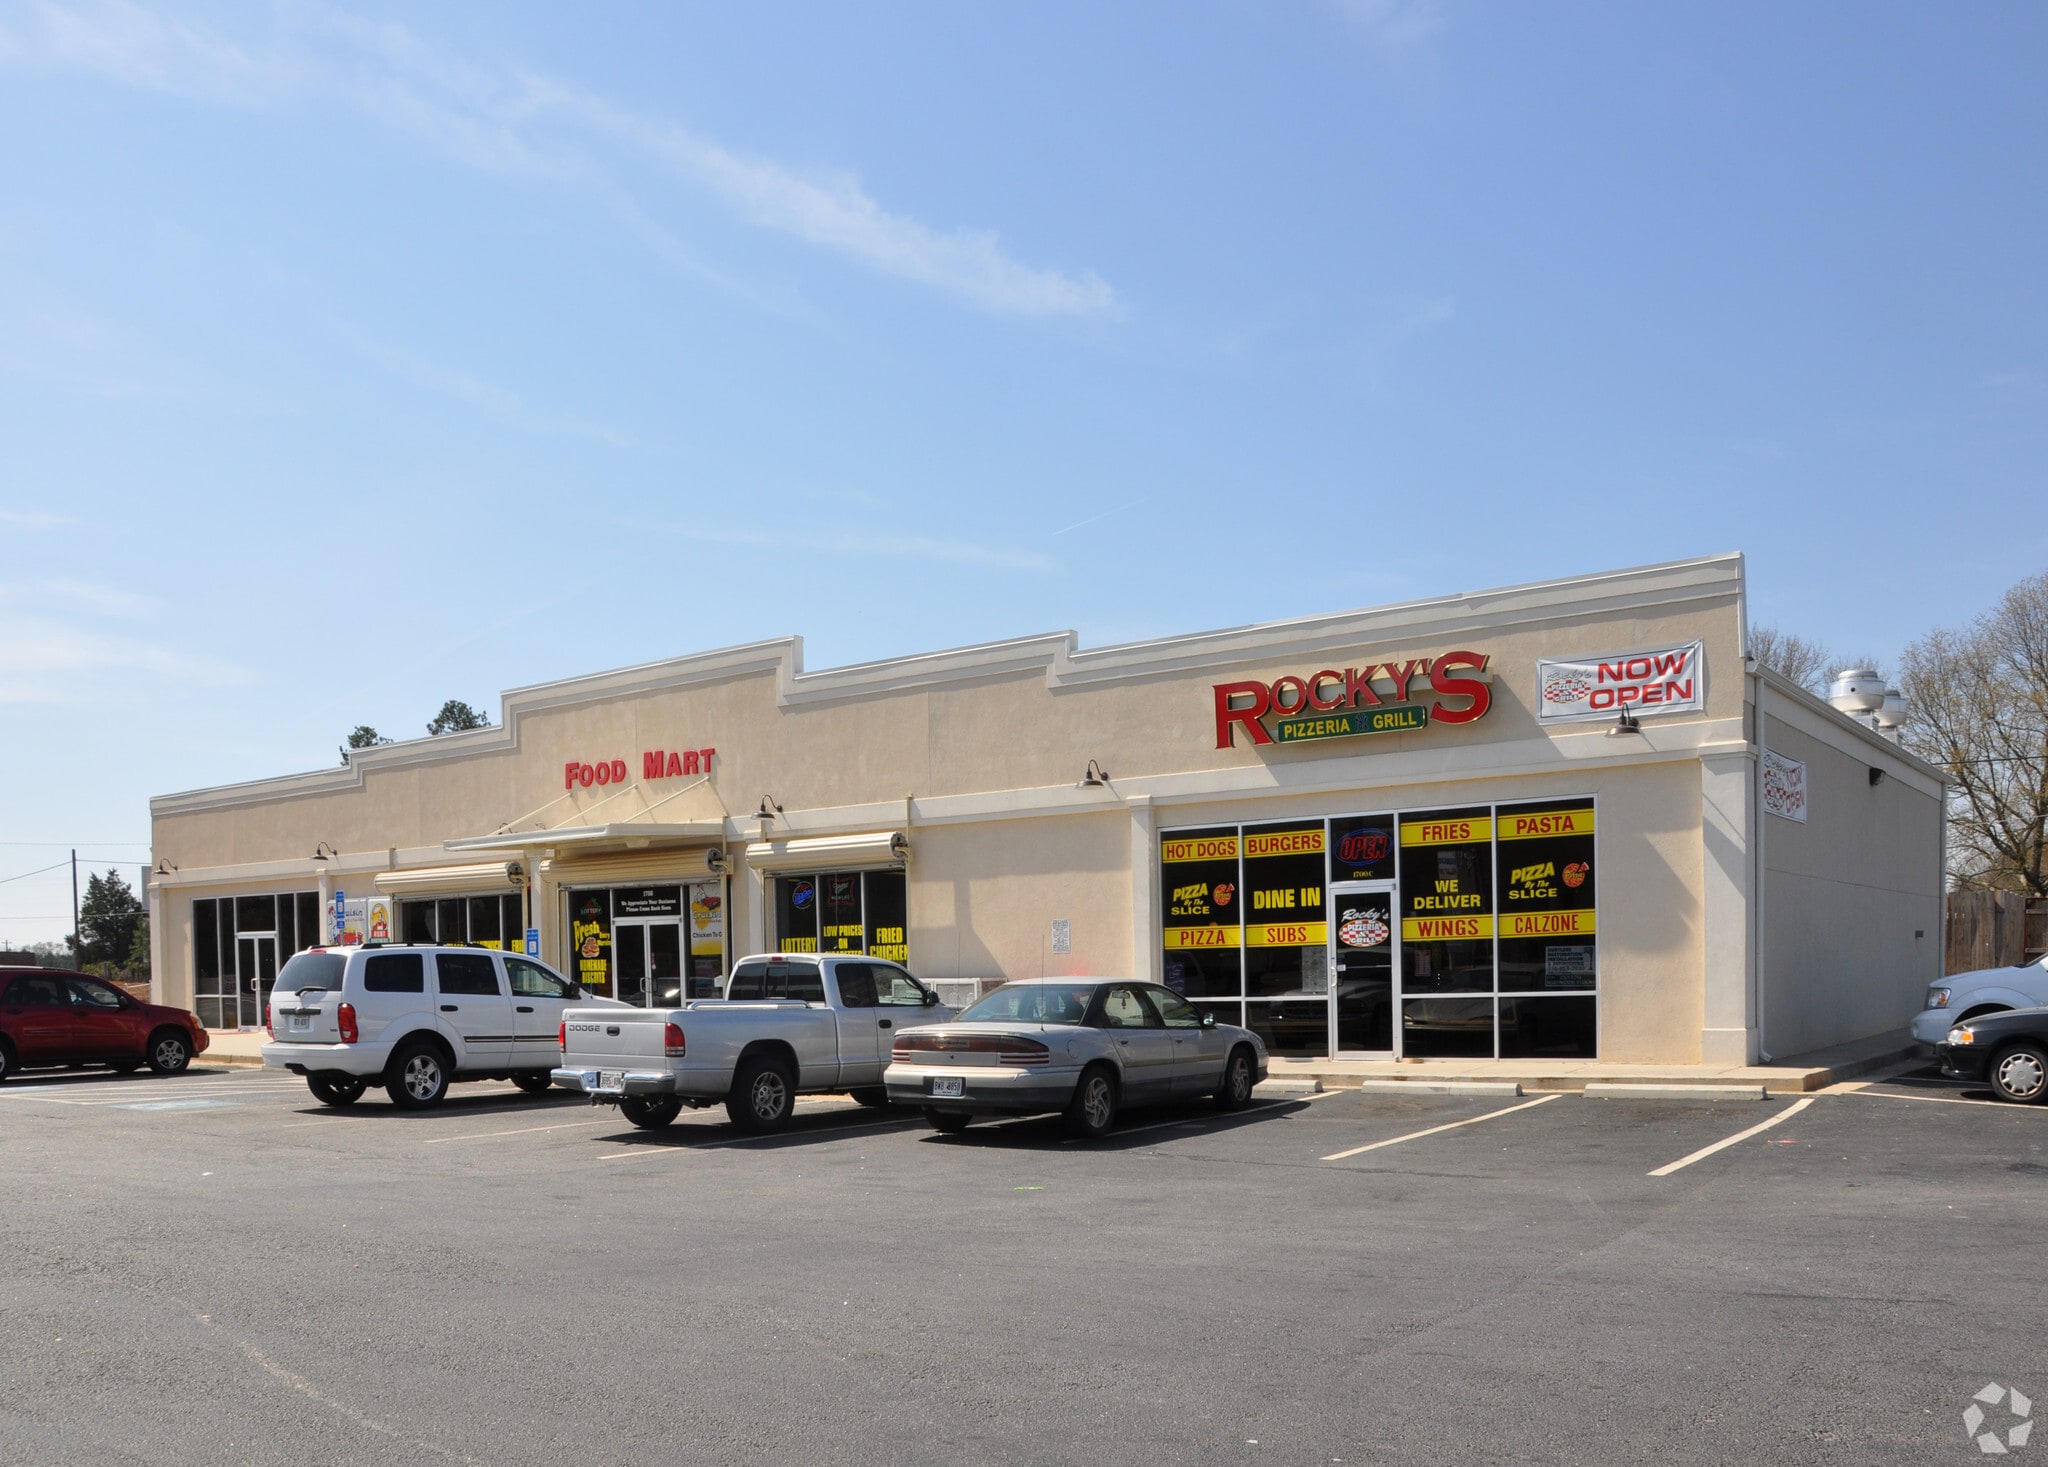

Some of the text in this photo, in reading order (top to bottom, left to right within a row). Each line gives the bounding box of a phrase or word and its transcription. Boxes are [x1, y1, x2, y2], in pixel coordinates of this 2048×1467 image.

[1598, 653, 1687, 684] NOW
[1212, 650, 1491, 749] ROCKY'S
[1590, 679, 1692, 709] OPEN
[1284, 720, 1350, 739] PIZZERIA
[1373, 712, 1416, 730] GRILL
[565, 748, 716, 790] FOOD MART
[1422, 823, 1471, 841] FRIES
[1516, 815, 1574, 834] PASTA
[1166, 841, 1236, 858] HOT DOGS
[1248, 834, 1322, 854] BURGERS
[1341, 836, 1388, 860] OPEN
[1510, 861, 1555, 884] PIZZA
[1173, 882, 1209, 902] PIZZA
[1435, 879, 1459, 893] WE
[1524, 879, 1550, 889] By The
[1253, 887, 1321, 910] DINE IN
[1414, 894, 1481, 910] DELIVER
[1508, 888, 1558, 900] SLICE
[1171, 906, 1210, 915] SLICE
[1341, 907, 1389, 922] Rocky's
[823, 924, 862, 937] LOW PRICES
[1347, 923, 1380, 931] PIZZERIA
[1417, 919, 1479, 937] WINGS
[1515, 914, 1580, 934] CALZONE
[573, 920, 600, 952] Fresh
[876, 927, 903, 944] FRIED
[1180, 930, 1226, 945] PIZZA
[1267, 926, 1307, 943] SUBS
[1350, 936, 1376, 944] GRILL
[781, 937, 817, 953] LOTTERY
[838, 938, 848, 949] ON
